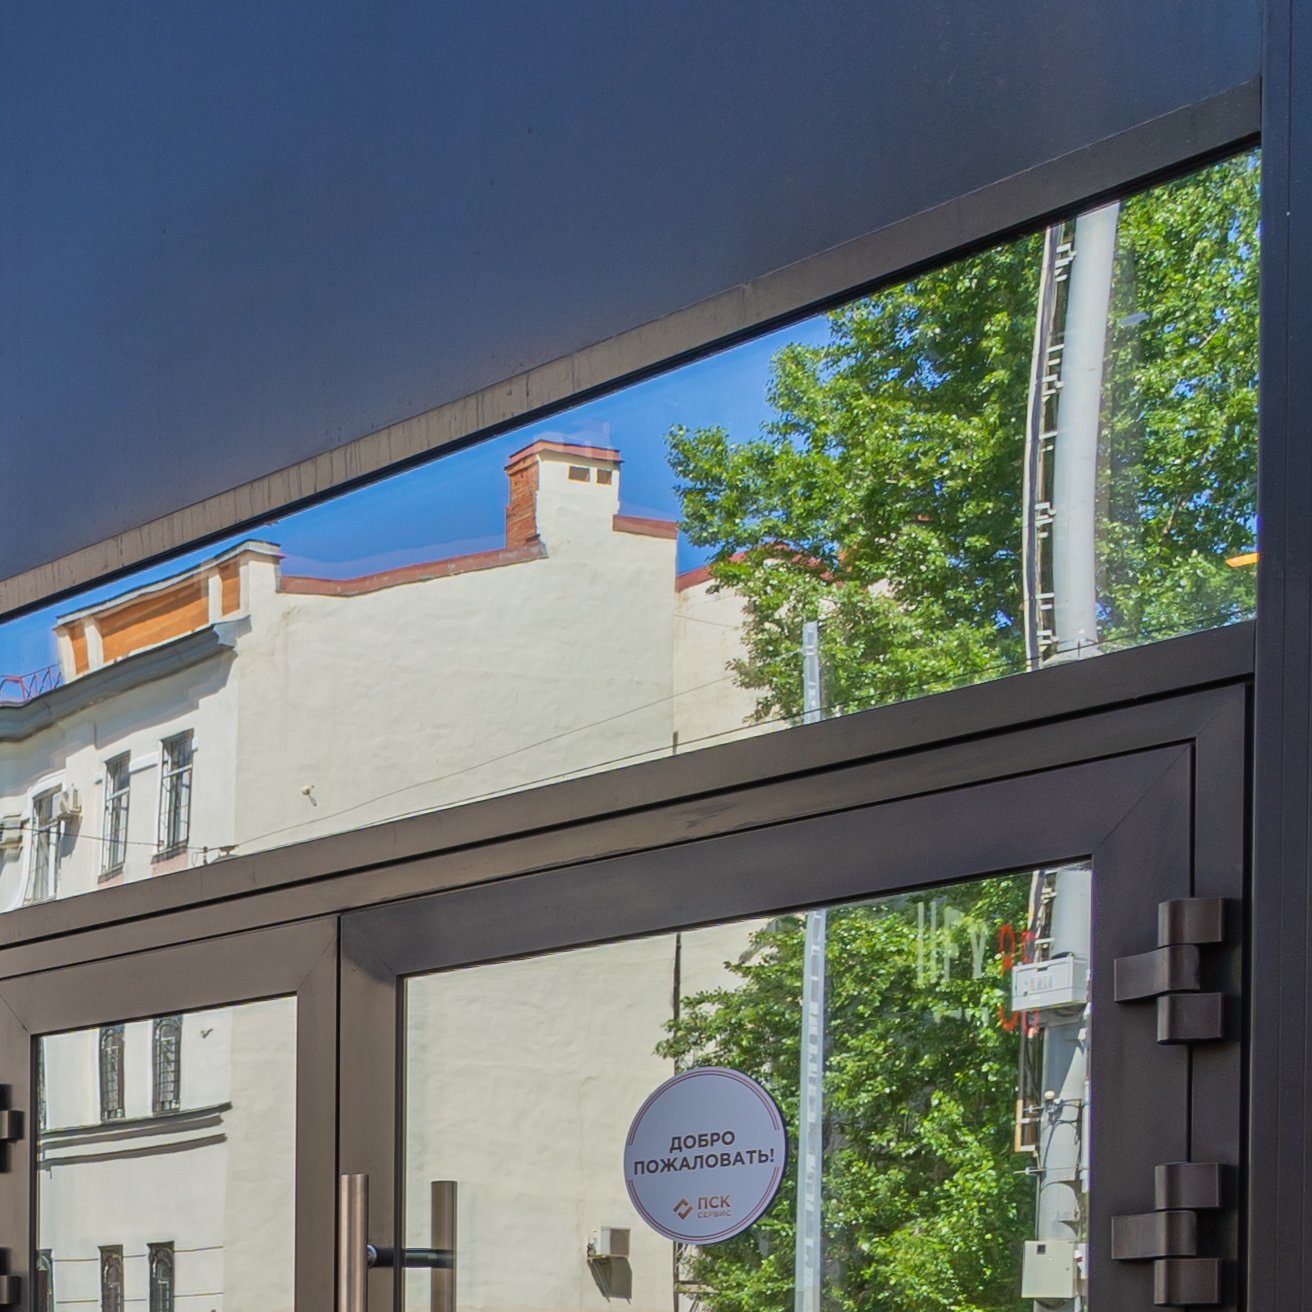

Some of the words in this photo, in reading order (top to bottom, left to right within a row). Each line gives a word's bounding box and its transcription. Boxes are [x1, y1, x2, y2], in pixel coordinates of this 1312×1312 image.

[669, 1130, 735, 1153] ДОБРО
[633, 1148, 775, 1175] ПОЖАЛОВАТЬ!
[697, 1195, 731, 1210] ПСК
[697, 1209, 732, 1219] СЕРВИС
